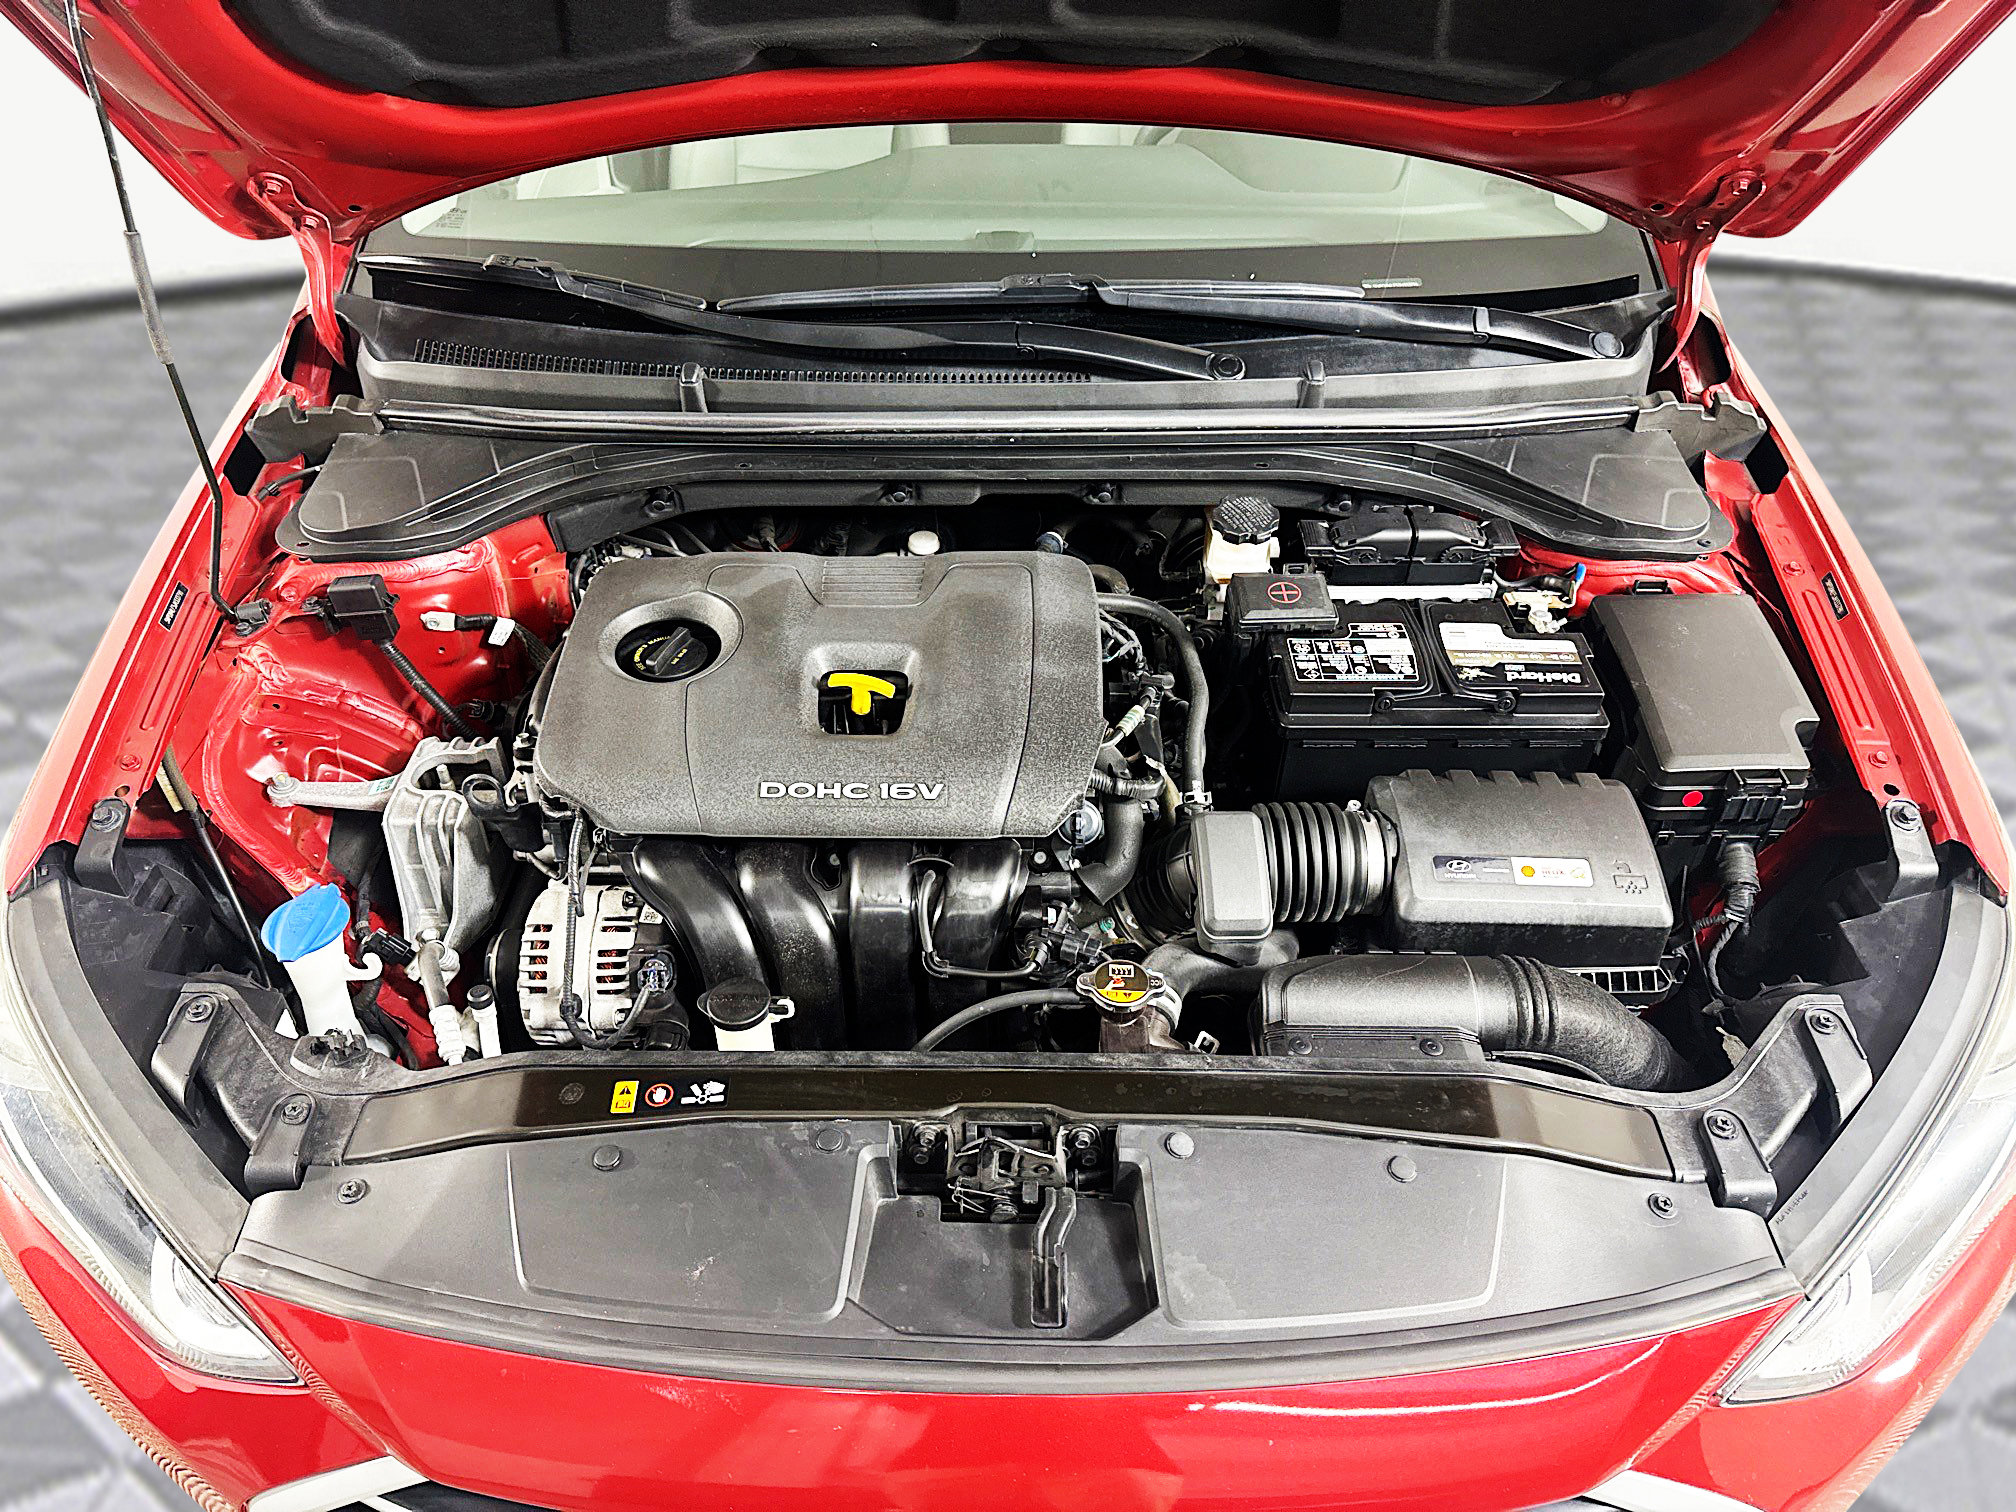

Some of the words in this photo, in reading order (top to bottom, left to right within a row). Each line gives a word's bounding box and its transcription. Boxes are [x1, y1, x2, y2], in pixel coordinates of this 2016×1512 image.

[1505, 671, 1581, 684] DieHard
[759, 781, 870, 799] DOHC
[879, 782, 945, 800] 16V
